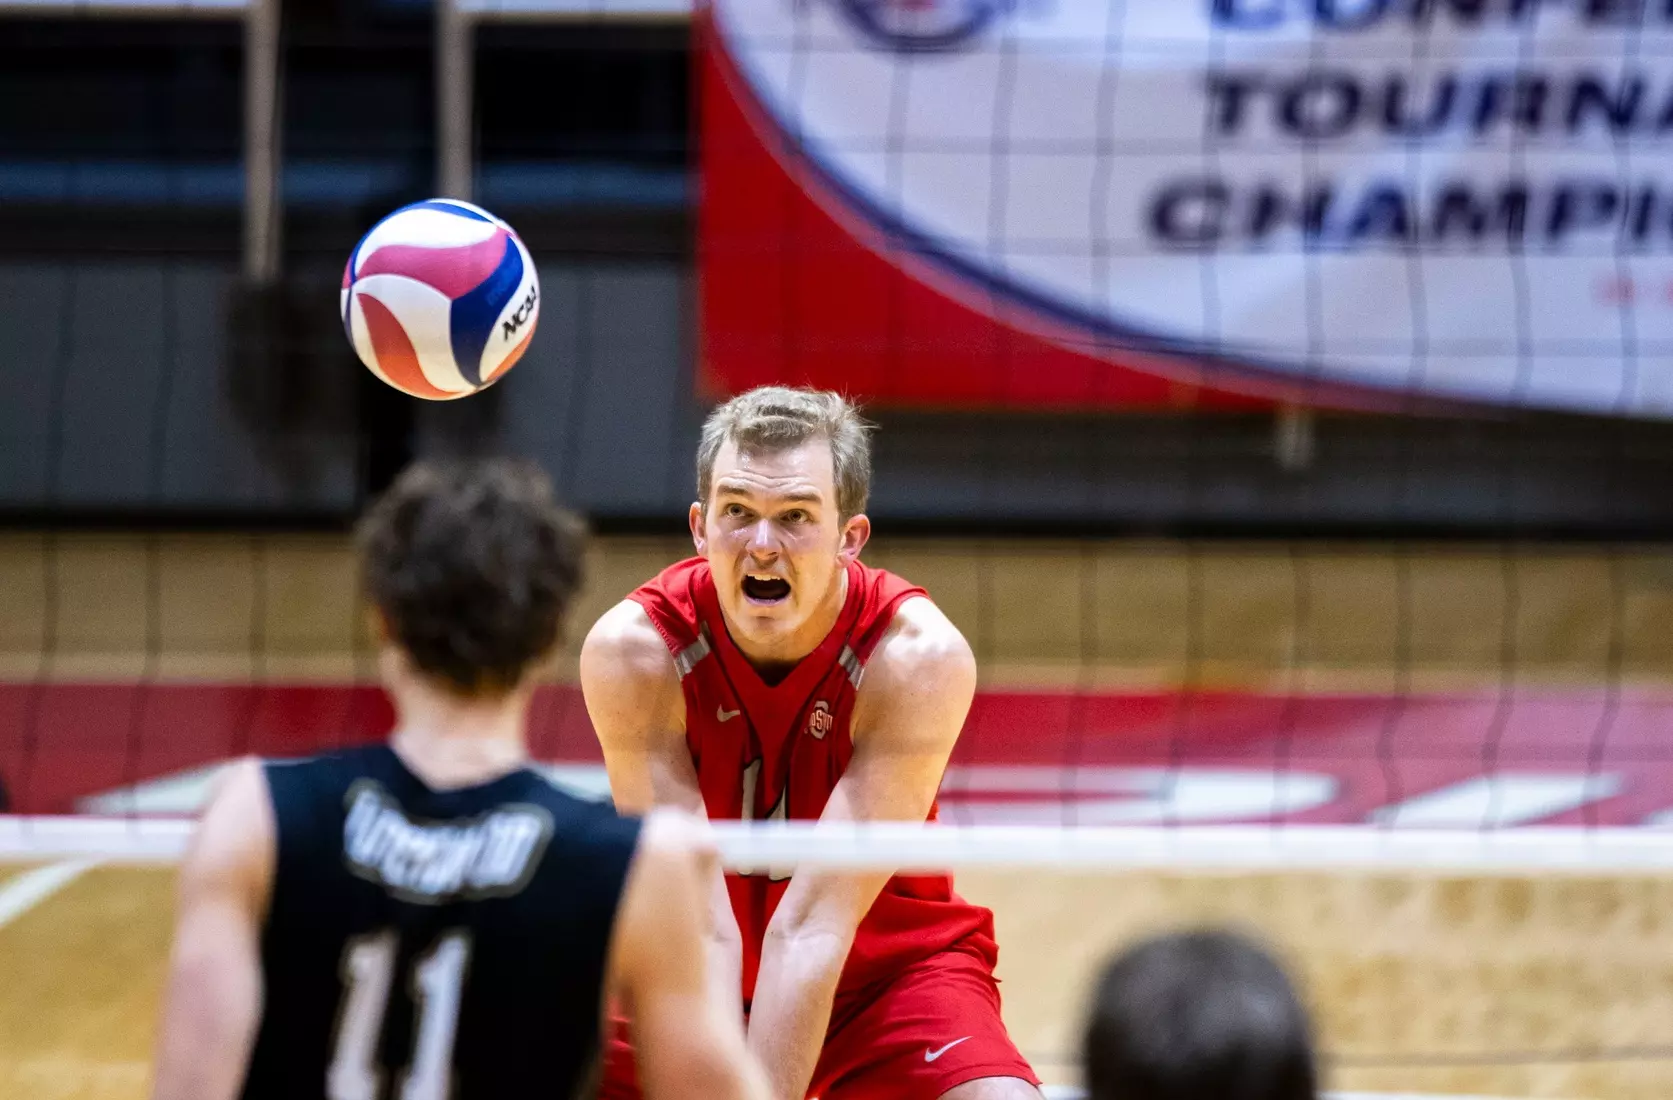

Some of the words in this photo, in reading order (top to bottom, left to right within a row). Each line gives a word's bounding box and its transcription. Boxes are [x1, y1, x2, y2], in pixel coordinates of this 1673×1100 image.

[1206, 69, 1673, 137] TOURN
[1150, 178, 1673, 247] CHAMPI
[503, 284, 537, 342] NCAA
[325, 932, 470, 1100] 11
